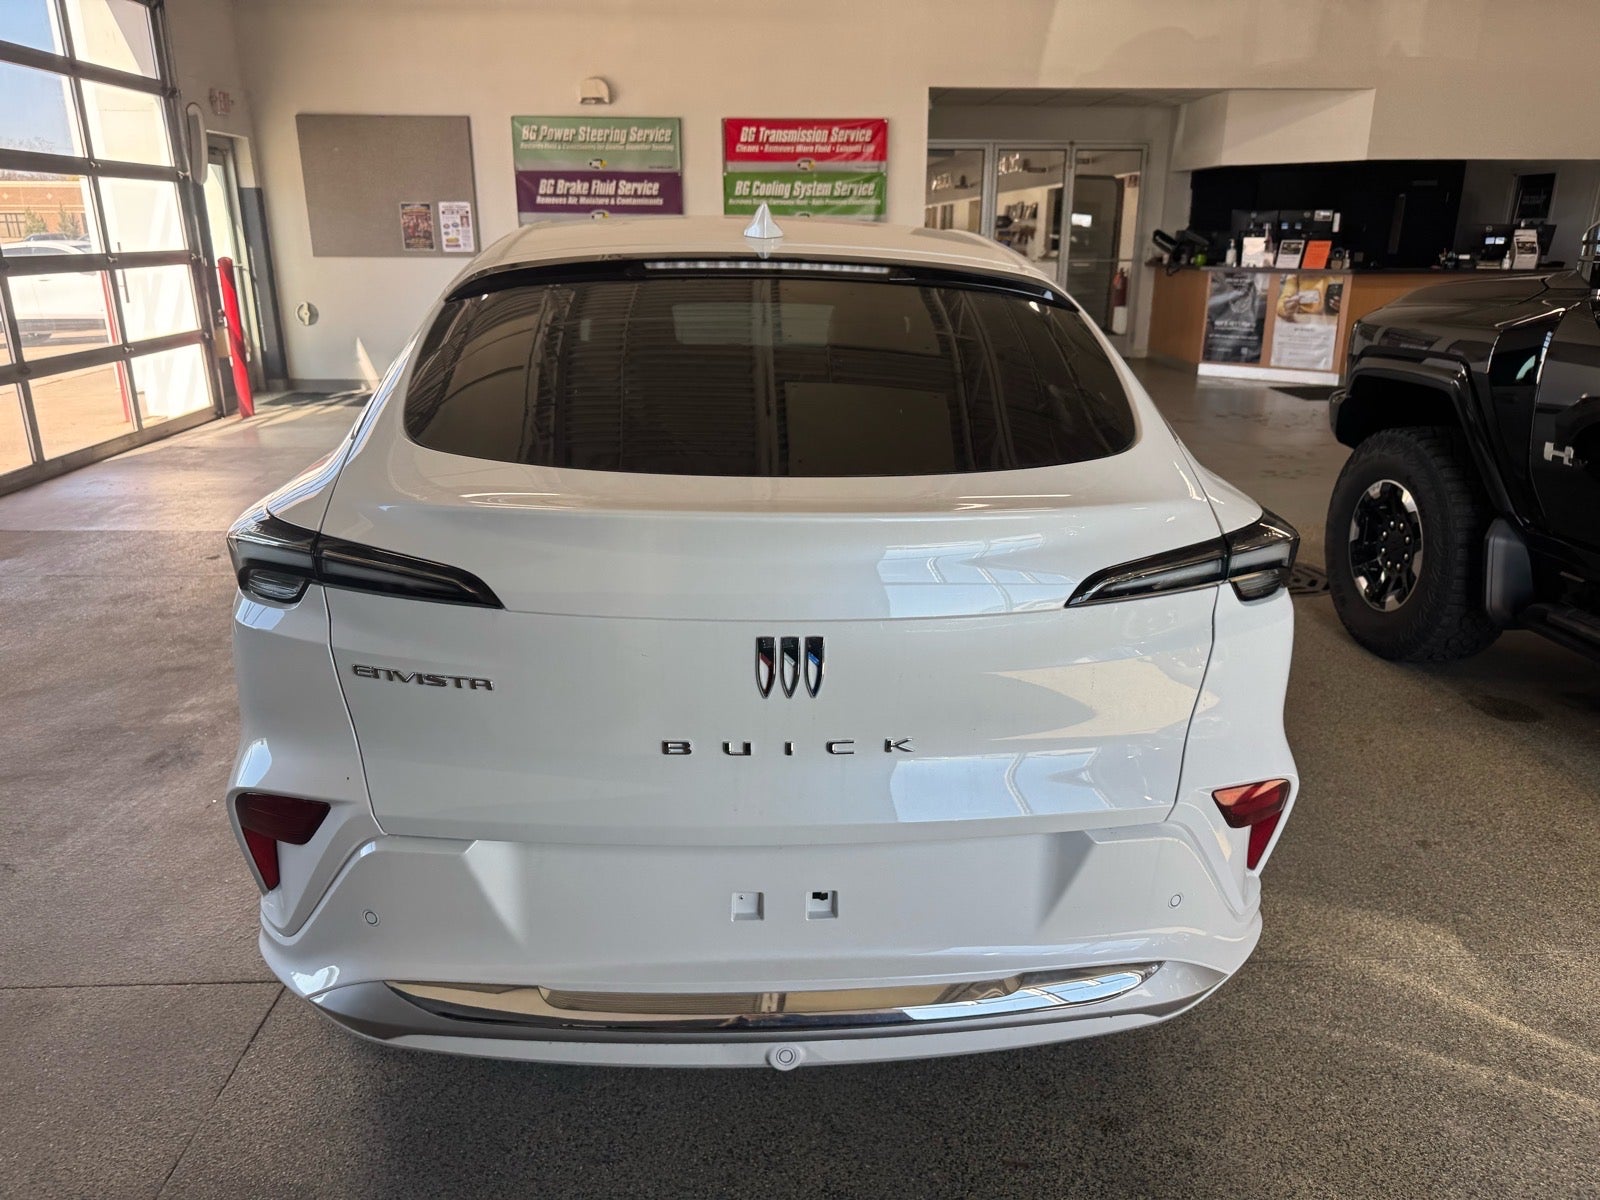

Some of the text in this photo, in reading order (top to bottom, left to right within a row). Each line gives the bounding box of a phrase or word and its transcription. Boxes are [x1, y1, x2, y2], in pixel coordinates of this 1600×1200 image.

[522, 125, 672, 145] BG Power Steering Service
[740, 126, 873, 143] BG Transmission Service
[539, 178, 660, 196] BG Brake Fluid Service
[735, 181, 876, 199] BG Cooling System Service
[352, 663, 494, 691] ENVISTA
[661, 737, 915, 756] BUICK
